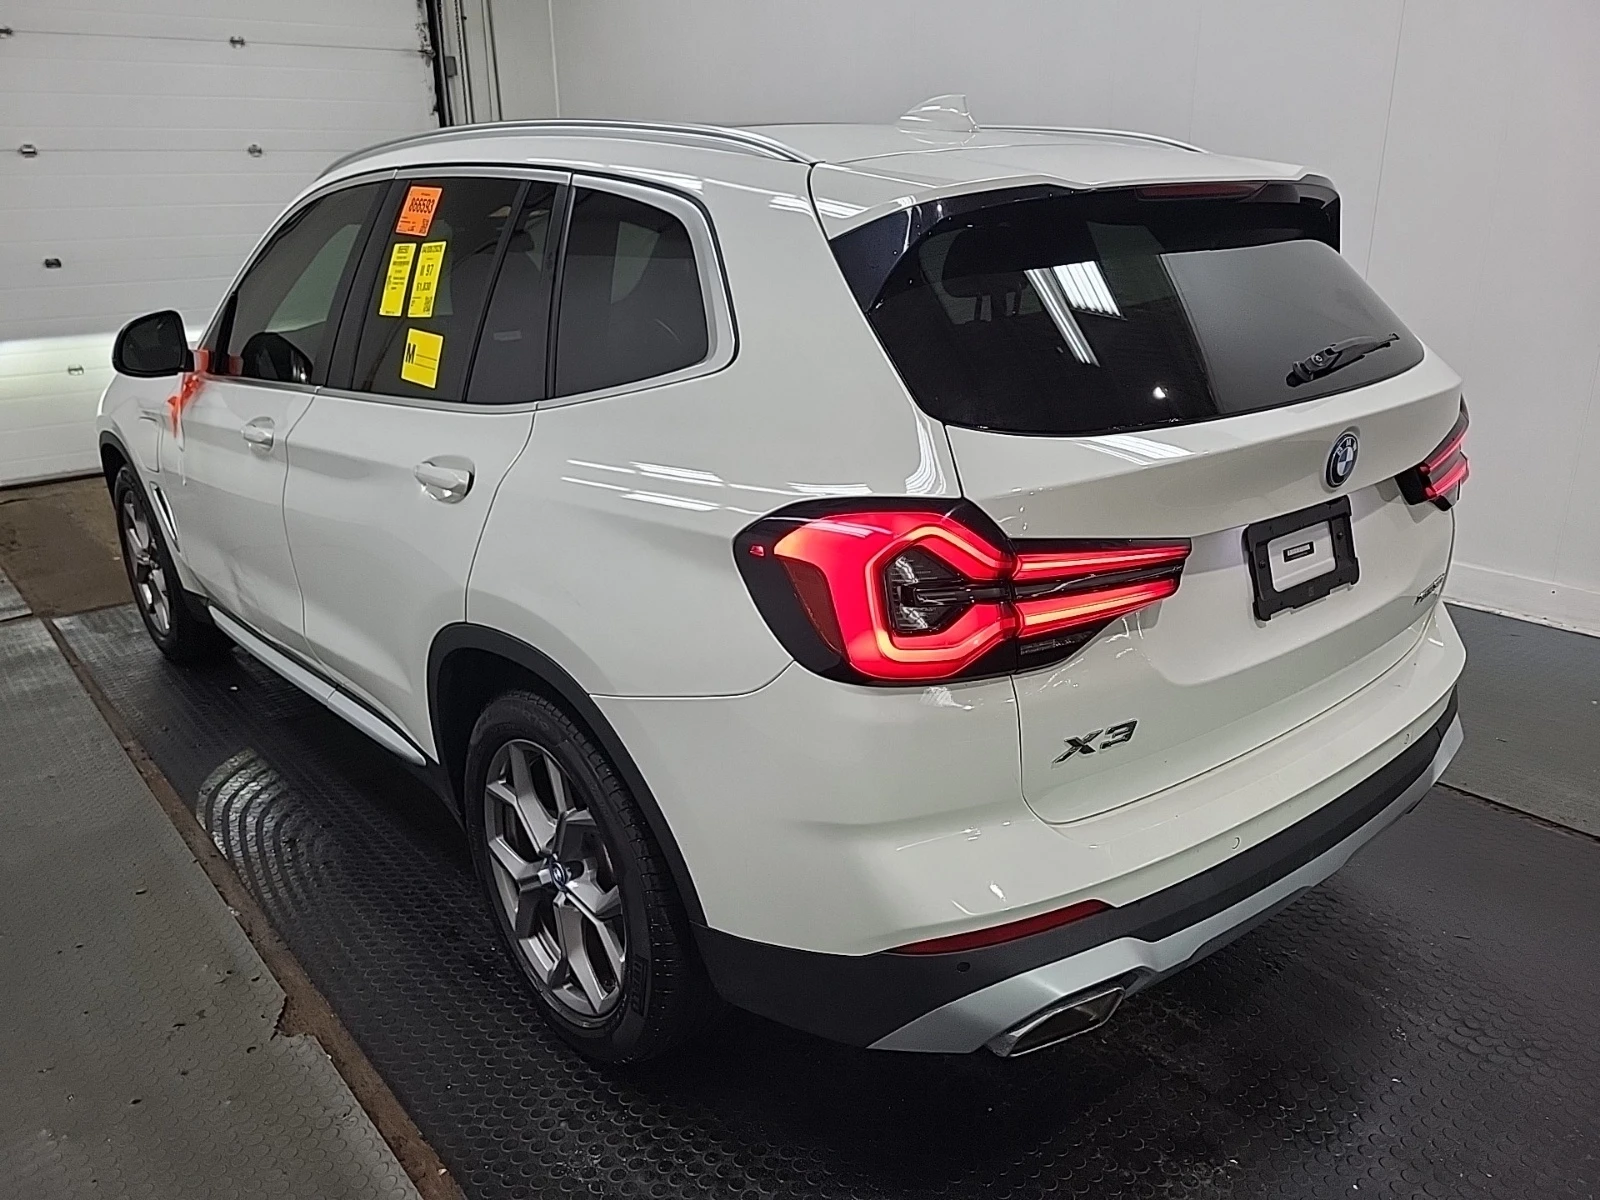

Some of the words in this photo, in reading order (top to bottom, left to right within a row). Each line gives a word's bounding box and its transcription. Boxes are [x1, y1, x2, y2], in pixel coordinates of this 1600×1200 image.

[405, 342, 417, 364] M
[1336, 438, 1357, 457] BMW
[1051, 717, 1138, 764] X3
